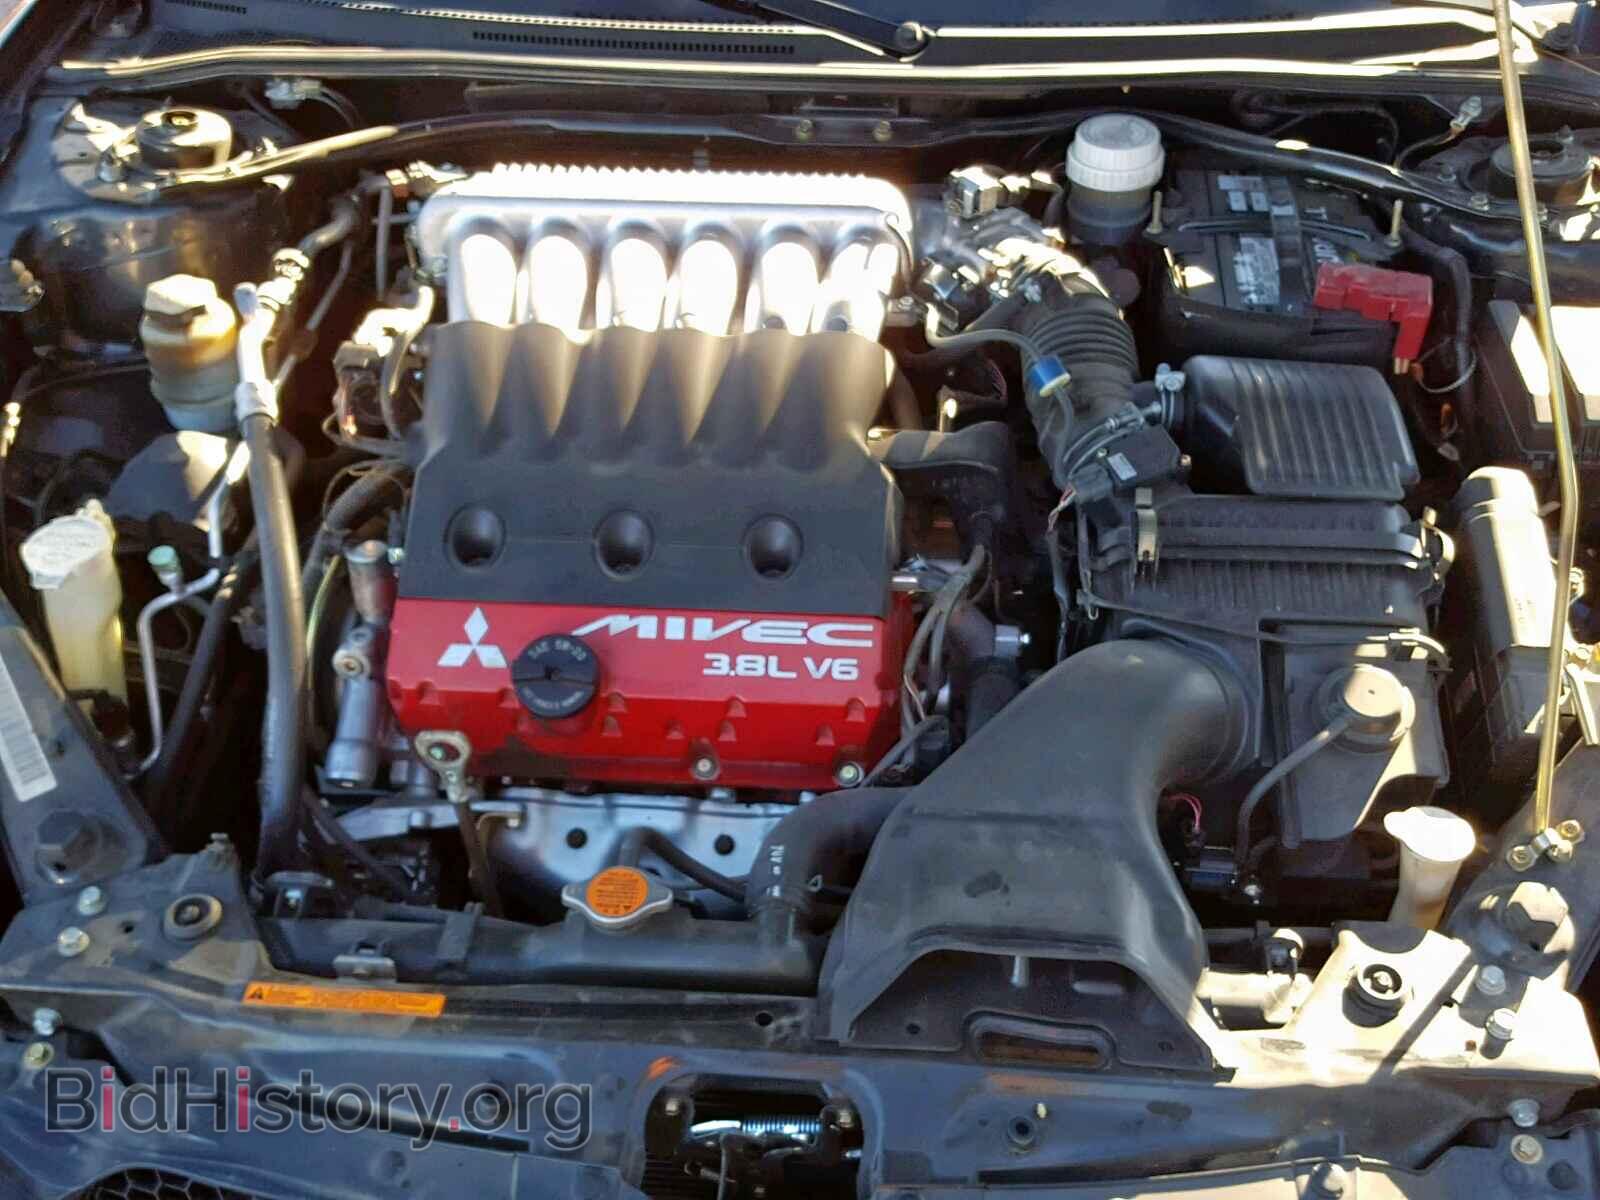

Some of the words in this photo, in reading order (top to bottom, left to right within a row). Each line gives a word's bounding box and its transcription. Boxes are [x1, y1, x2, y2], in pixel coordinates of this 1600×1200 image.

[571, 614, 874, 647] MIVEC
[703, 652, 797, 679] 3.8L
[803, 656, 859, 681] V6
